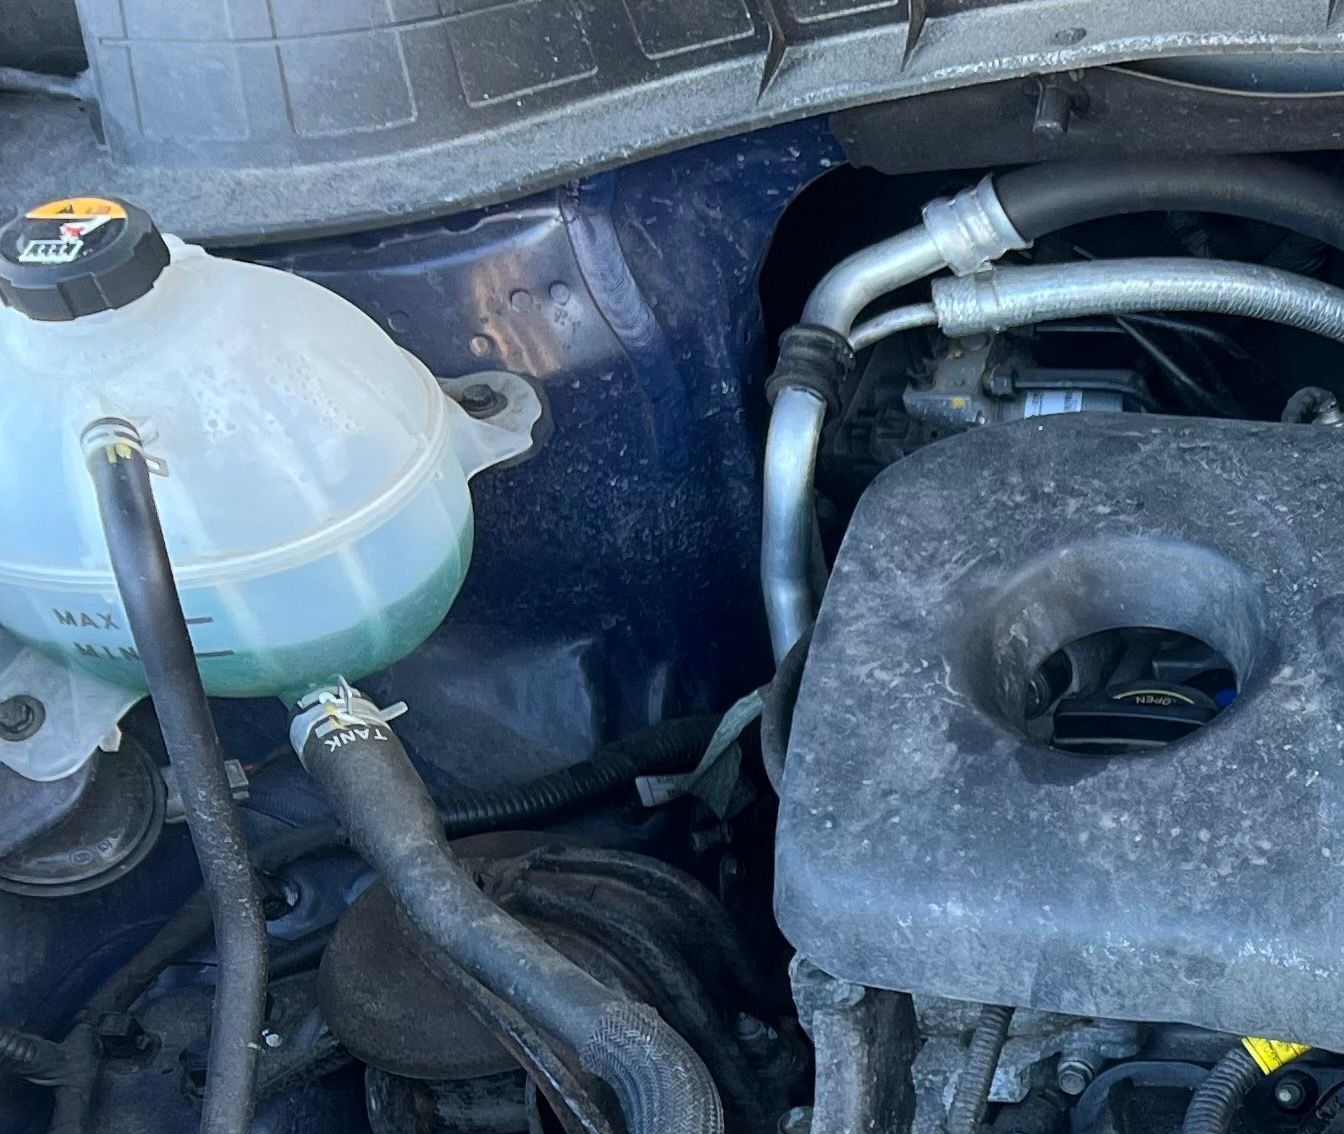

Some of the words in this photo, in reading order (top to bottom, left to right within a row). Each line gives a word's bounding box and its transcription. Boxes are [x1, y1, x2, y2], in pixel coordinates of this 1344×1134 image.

[53, 607, 120, 630] MAX
[1135, 694, 1172, 706] OPEN
[323, 728, 388, 753] TANK
